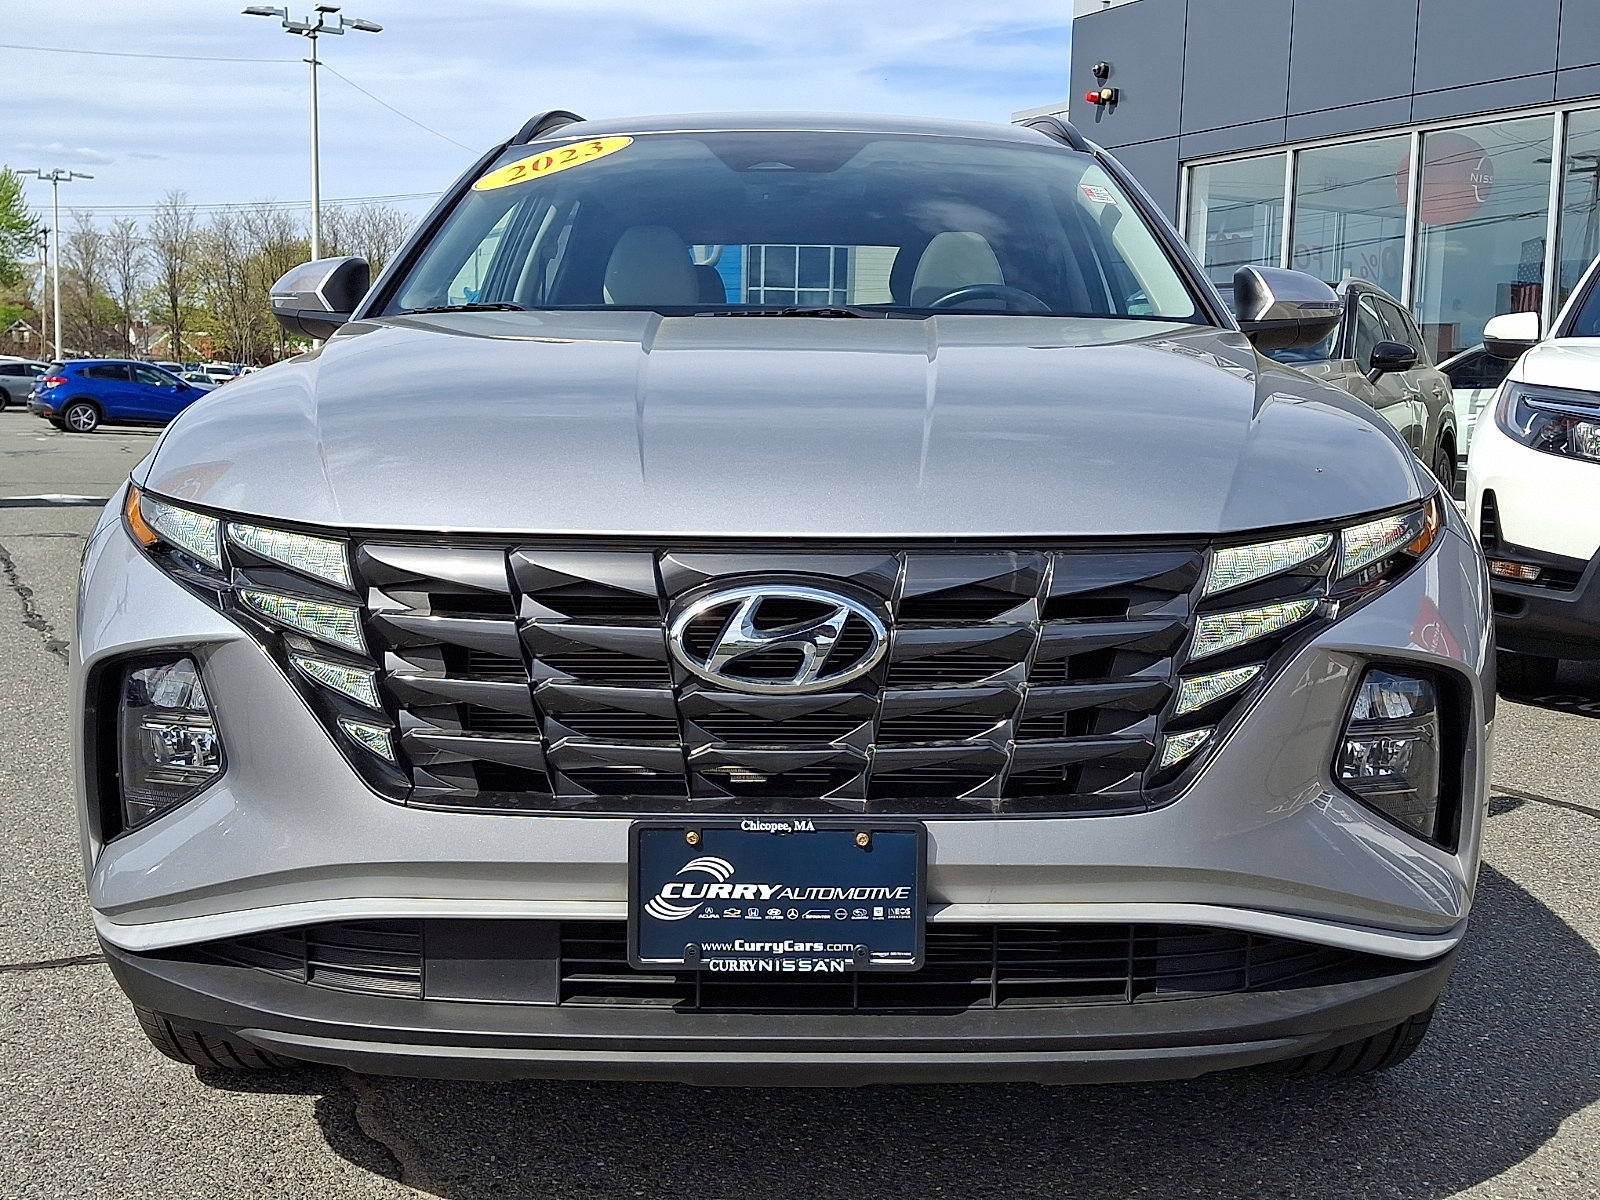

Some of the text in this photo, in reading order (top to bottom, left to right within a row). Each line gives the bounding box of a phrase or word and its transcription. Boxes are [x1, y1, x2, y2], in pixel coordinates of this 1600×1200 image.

[506, 141, 603, 183] 2023
[741, 820, 815, 833] Chicopee, MA
[660, 883, 912, 900] CURRY AUTOMOTIVE
[701, 939, 854, 954] www.CurryCars.com
